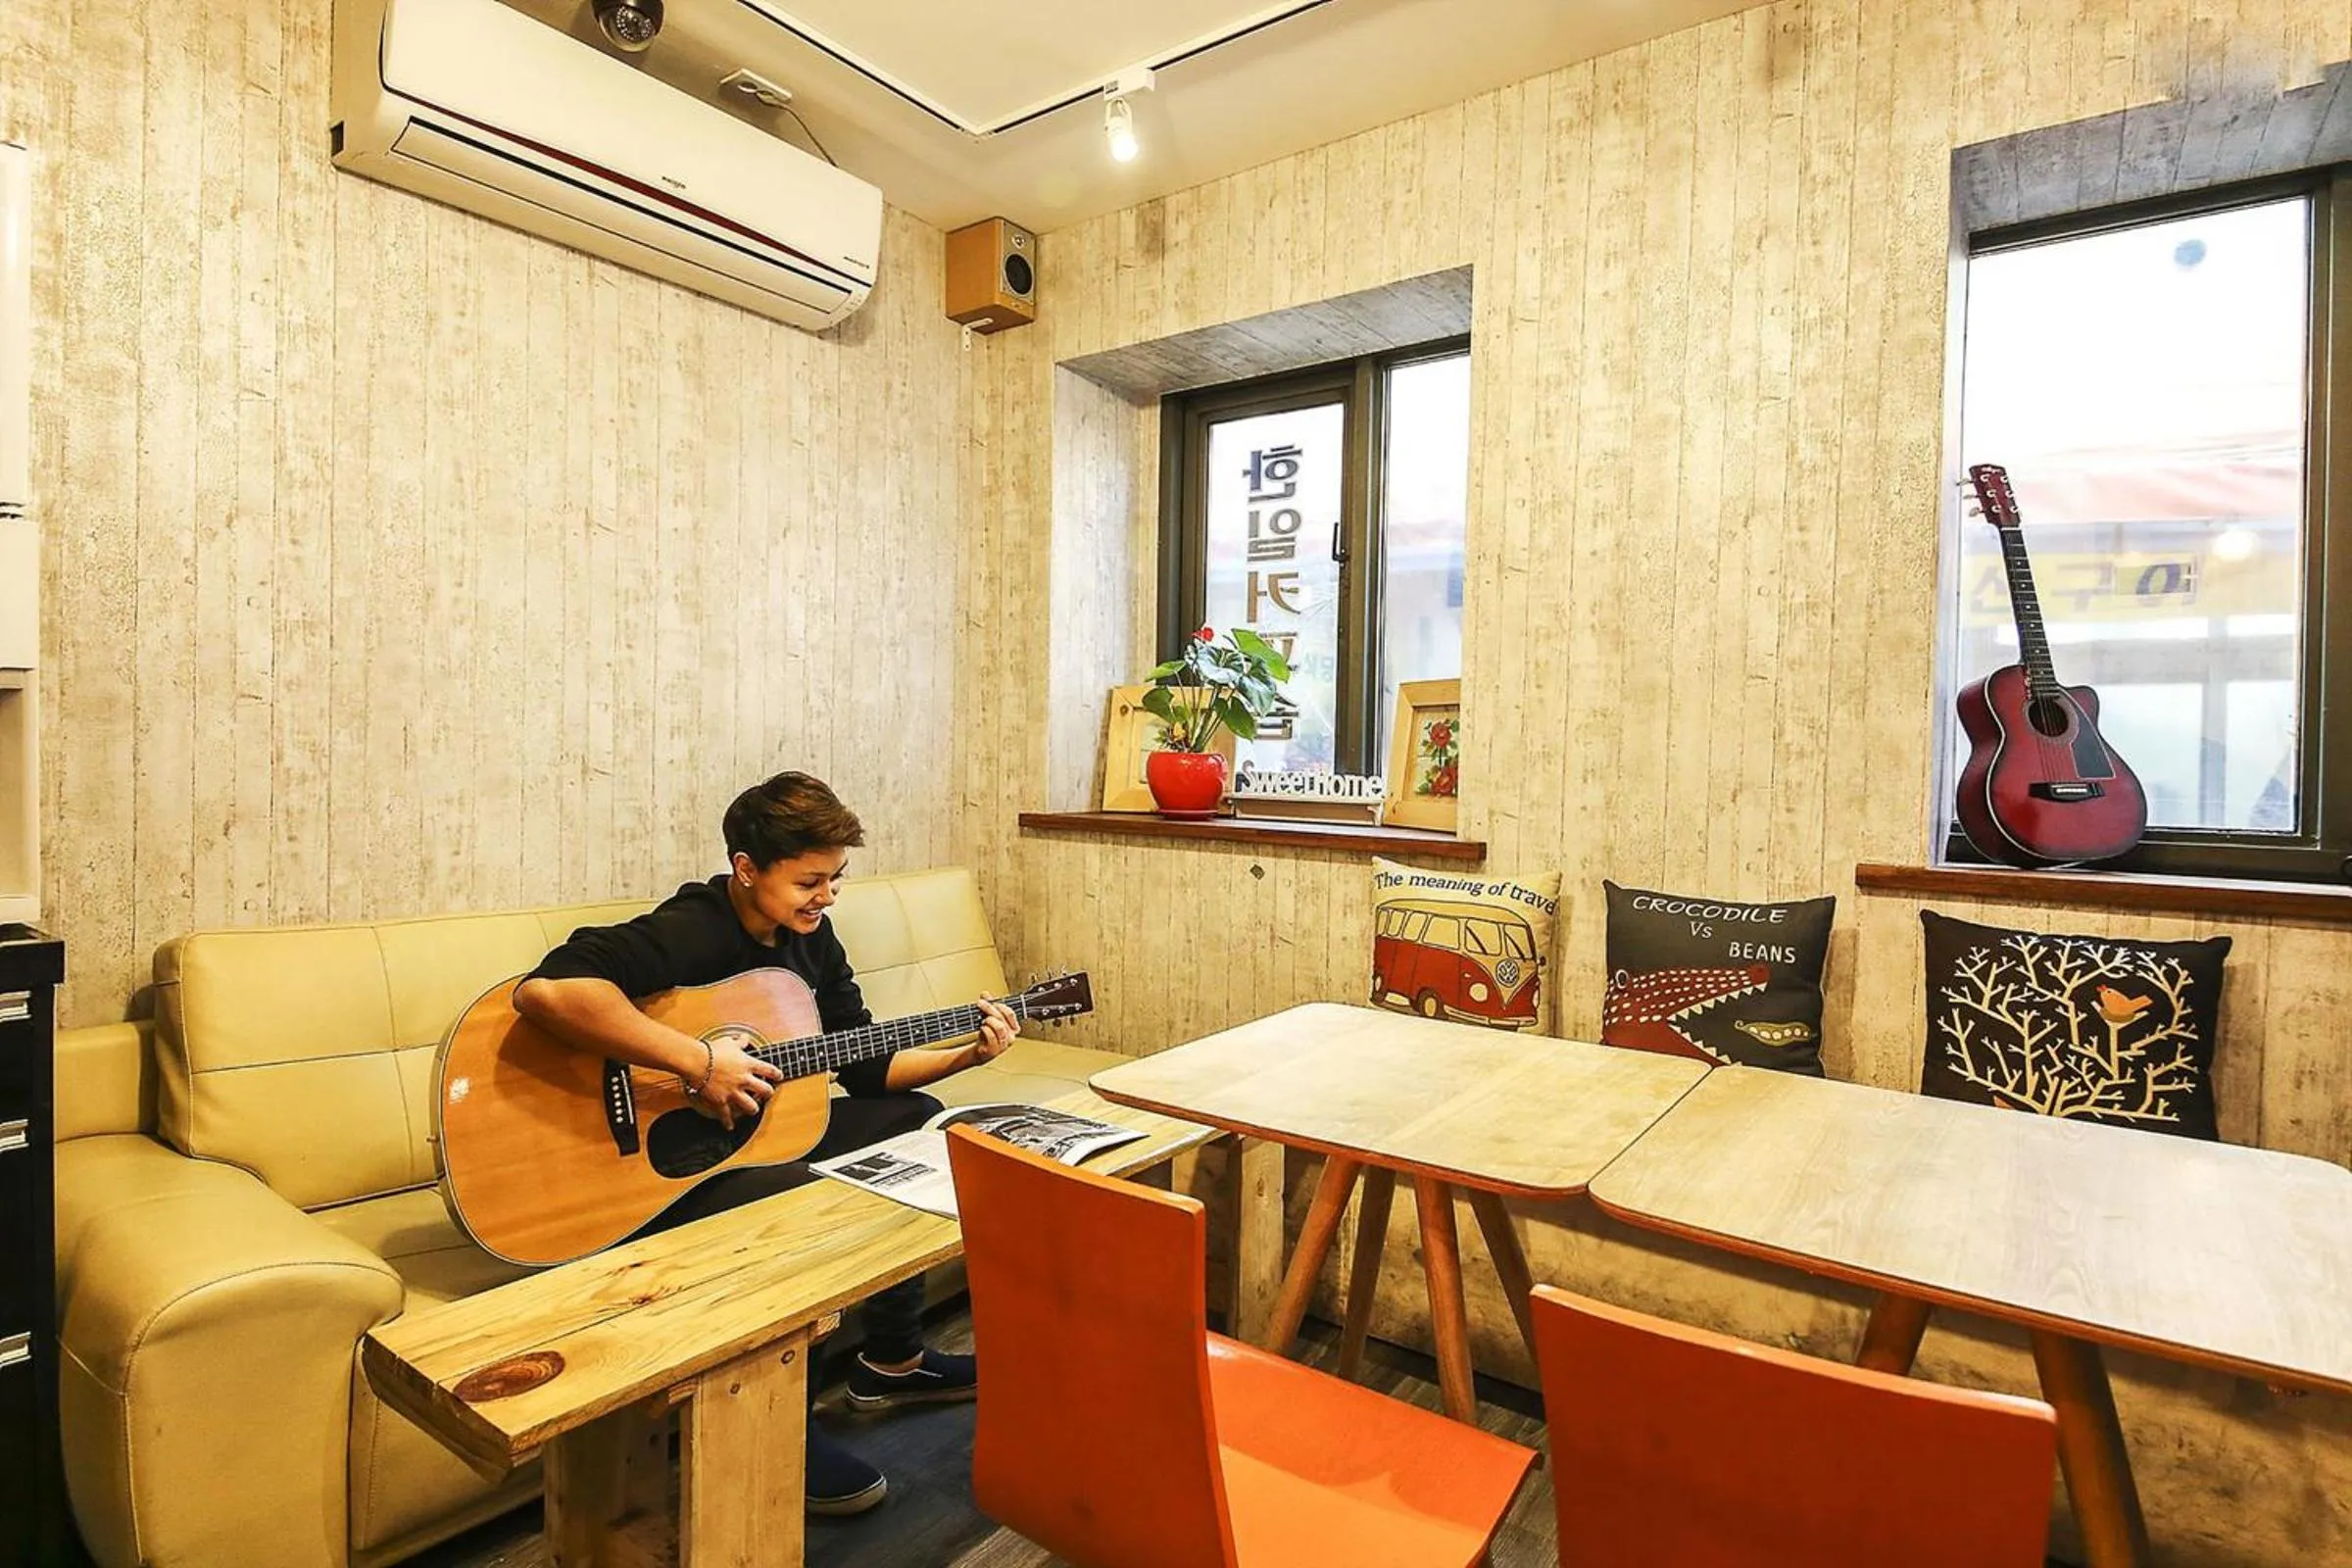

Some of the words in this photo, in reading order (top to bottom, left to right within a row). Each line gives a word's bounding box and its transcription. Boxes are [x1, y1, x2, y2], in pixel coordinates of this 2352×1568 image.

[1374, 871, 1403, 890] The
[1408, 873, 1485, 897] meaning
[1488, 882, 1510, 897] of
[1509, 885, 1558, 916] trave
[1633, 896, 1788, 923] CROCODILE
[1729, 941, 1796, 964] BEANS
